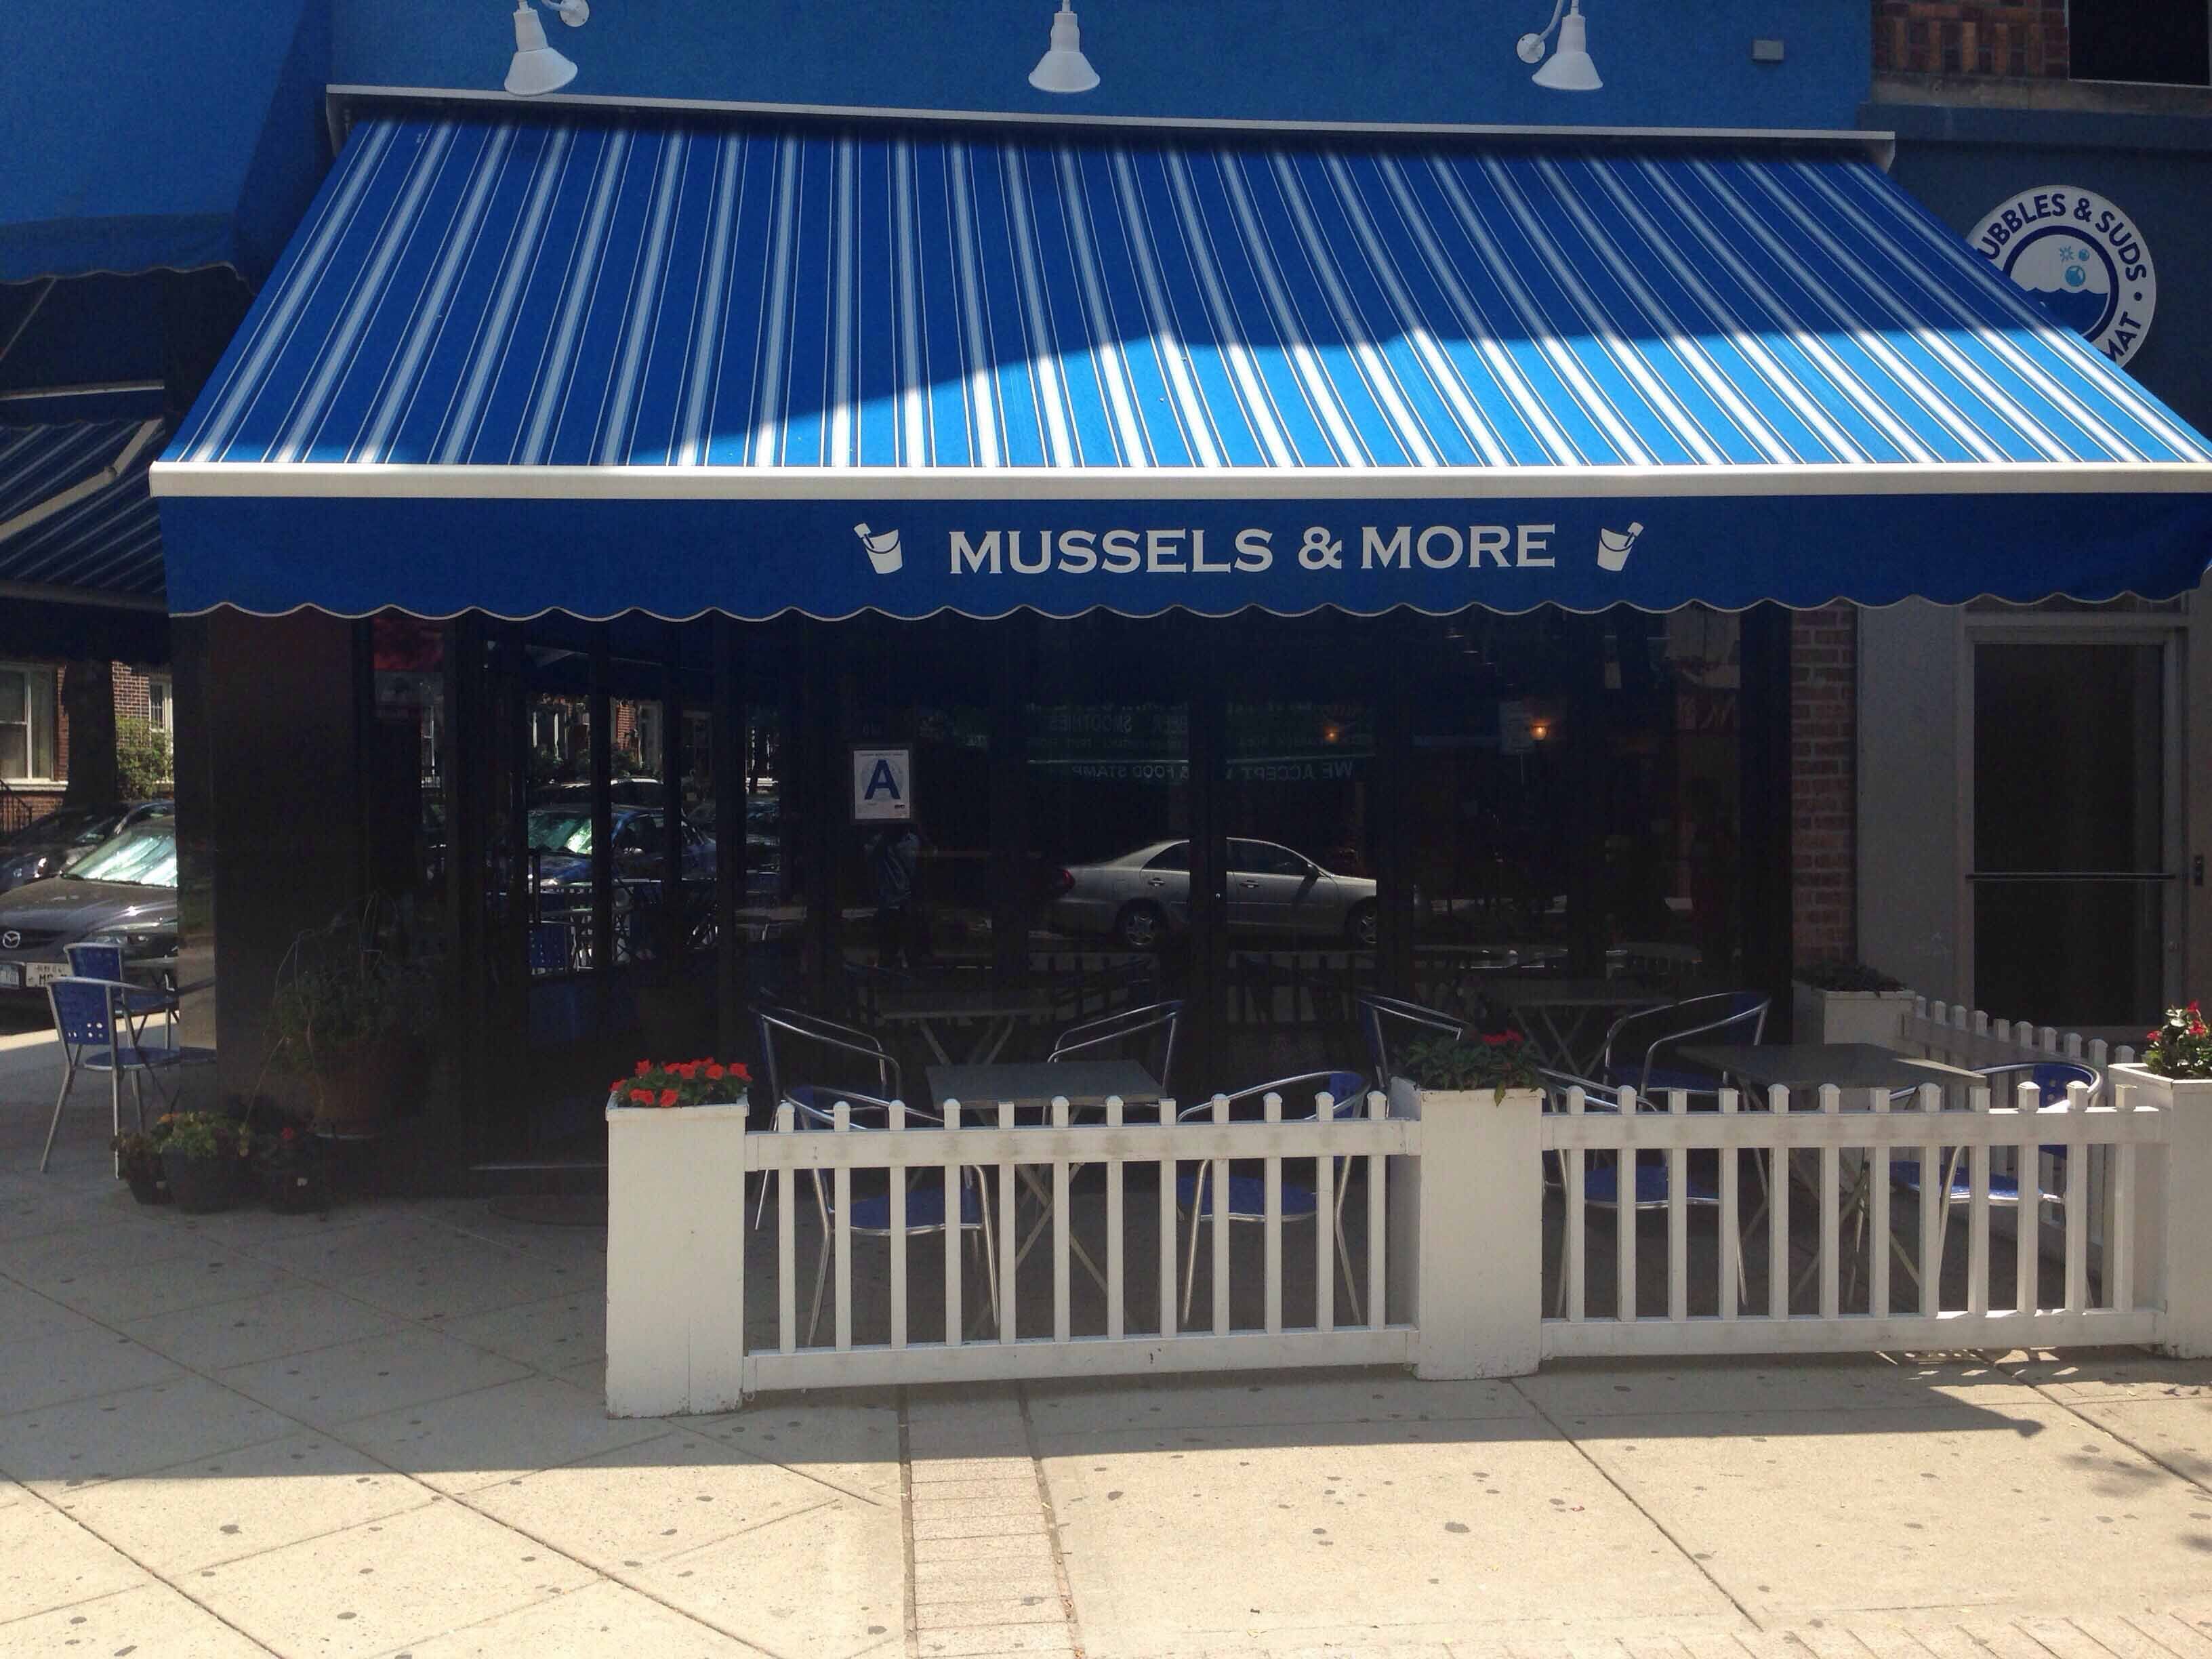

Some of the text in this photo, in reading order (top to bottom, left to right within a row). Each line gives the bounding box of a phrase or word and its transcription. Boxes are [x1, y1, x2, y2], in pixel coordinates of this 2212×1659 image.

[1976, 192, 2148, 282] UBBLES & SUDS
[949, 524, 1555, 574] MUSSELS & MORE
[864, 759, 901, 800] A
